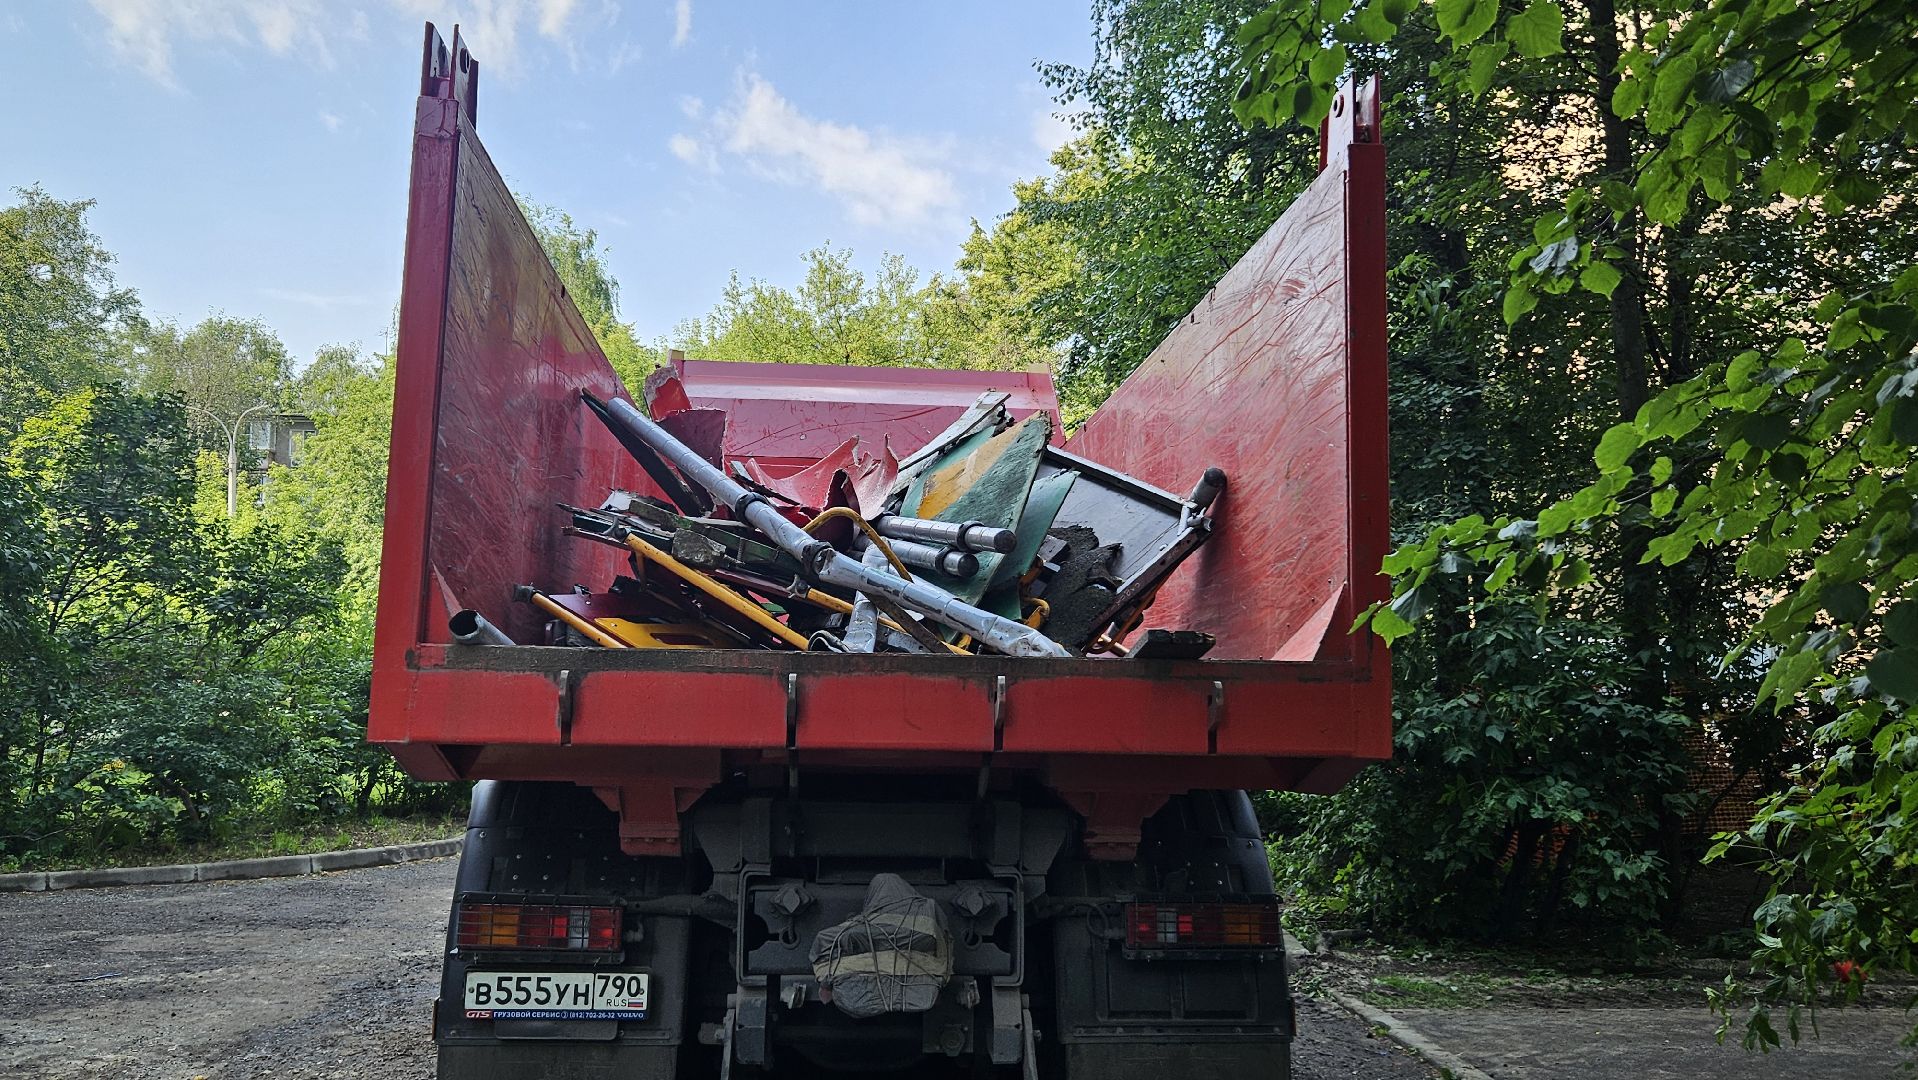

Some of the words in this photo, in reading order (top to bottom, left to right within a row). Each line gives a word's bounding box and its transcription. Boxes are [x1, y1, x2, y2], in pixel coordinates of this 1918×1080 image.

[597, 975, 641, 998] 790
[606, 999, 628, 1007] RUS
[466, 1010, 491, 1018] GTS
